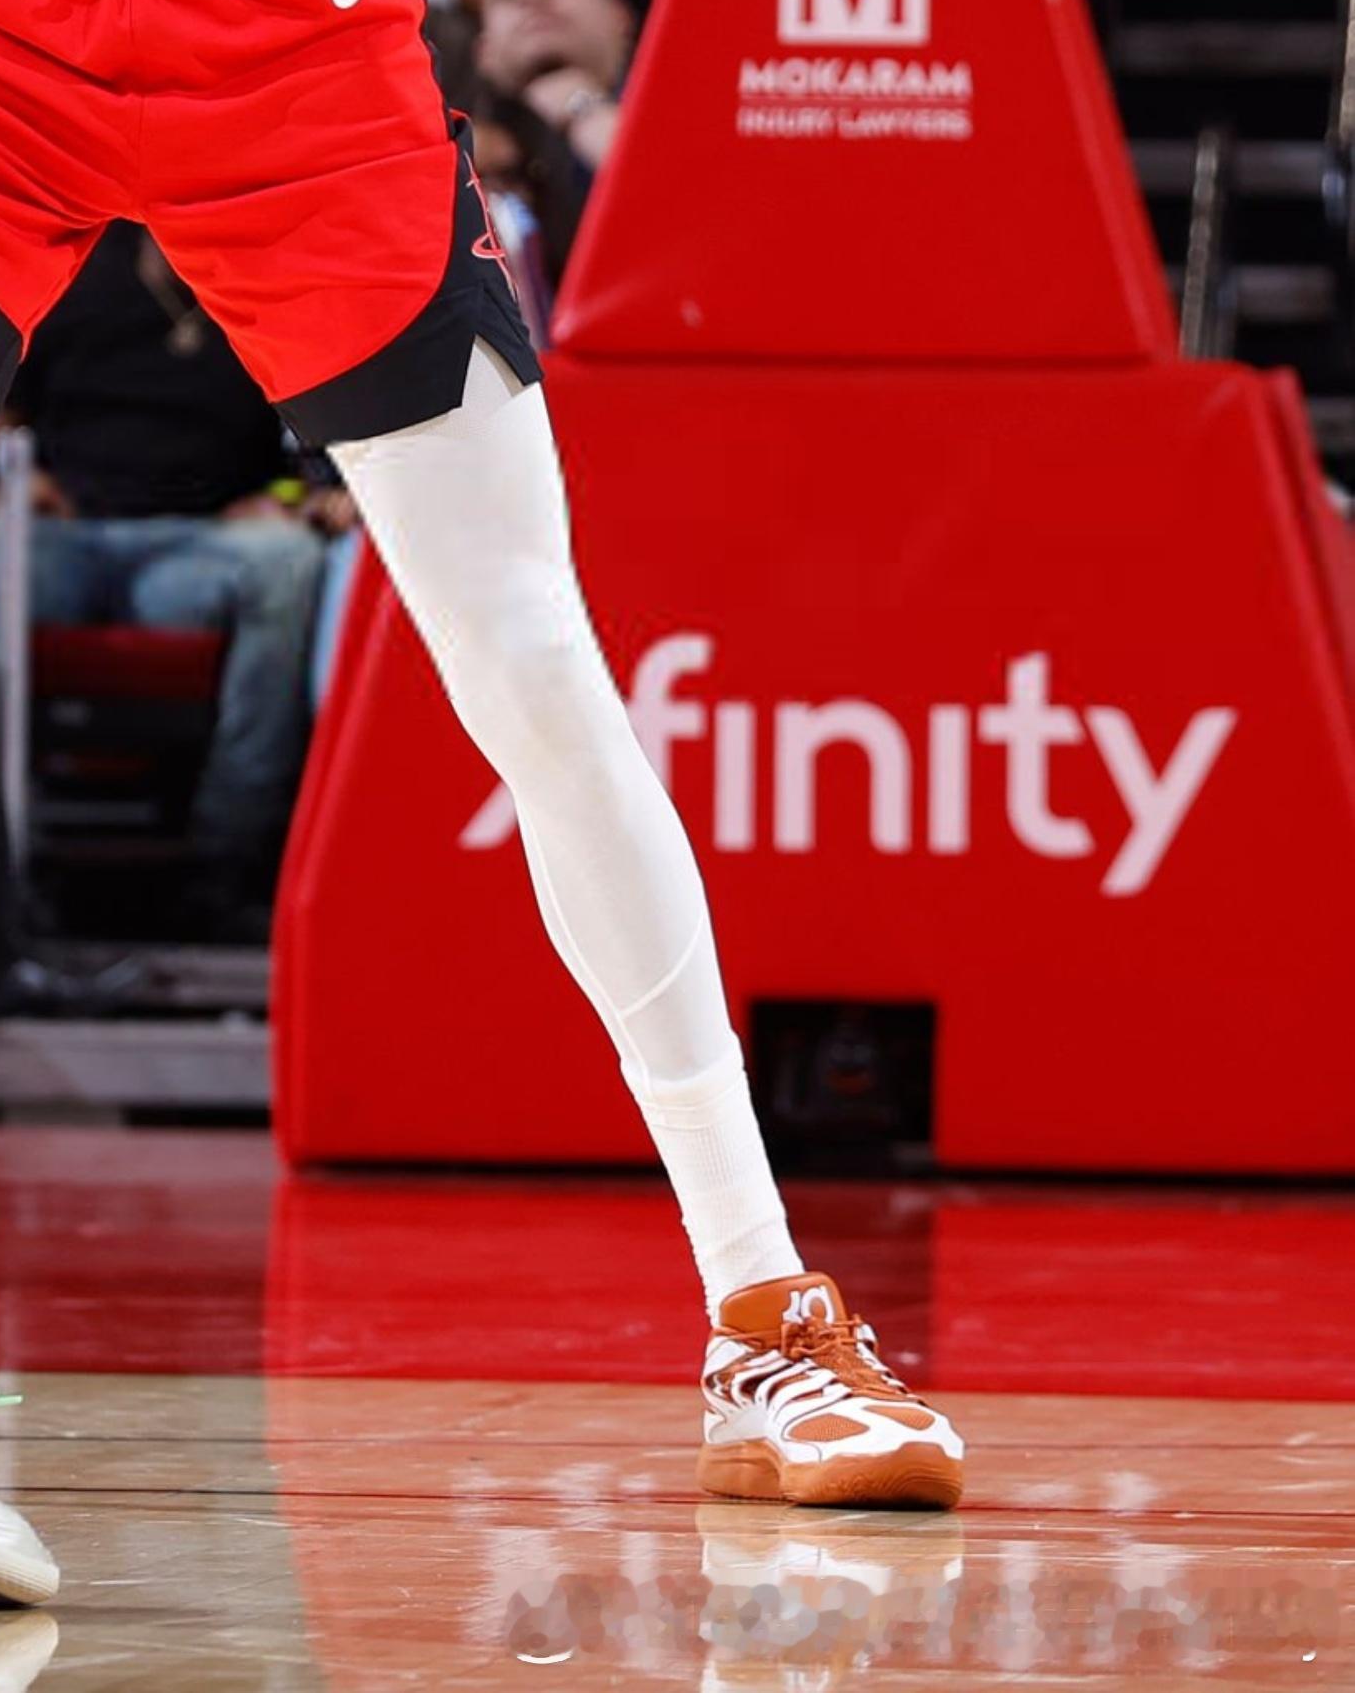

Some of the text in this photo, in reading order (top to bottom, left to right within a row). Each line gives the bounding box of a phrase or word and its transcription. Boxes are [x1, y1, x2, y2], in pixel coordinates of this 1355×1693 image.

[738, 57, 974, 97] MOKARAM
[736, 106, 974, 141] INJURY LAWYERS
[457, 632, 1239, 898] finity
